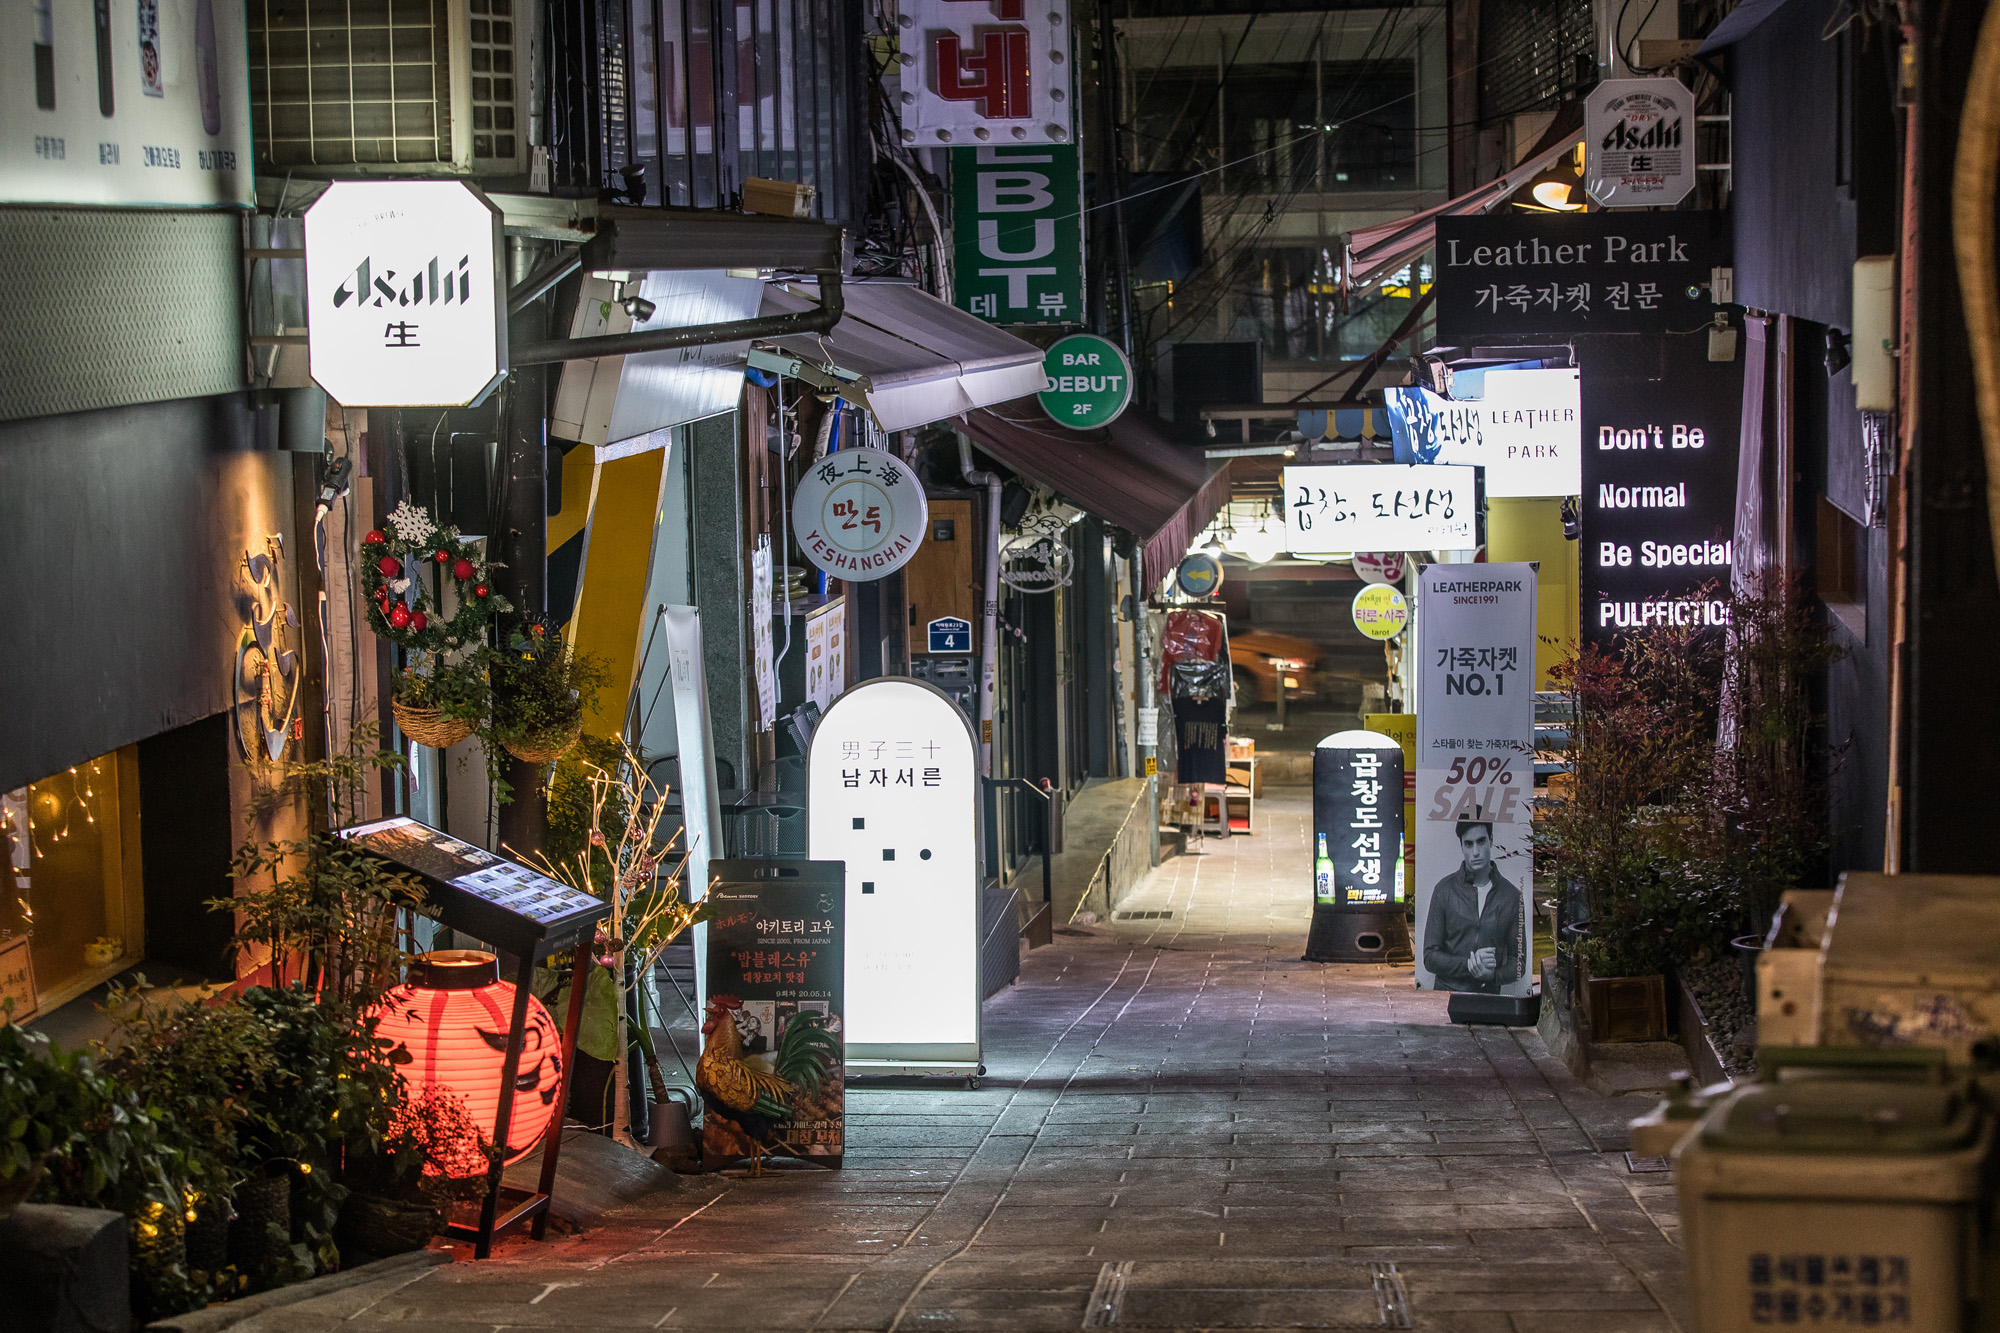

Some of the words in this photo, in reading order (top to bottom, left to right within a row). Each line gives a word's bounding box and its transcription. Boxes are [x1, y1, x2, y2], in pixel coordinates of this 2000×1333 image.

[1602, 115, 1682, 150] Asahi
[1631, 155, 1653, 171] 生
[1447, 237, 1592, 266] Leather
[1604, 235, 1690, 263] Park
[333, 254, 470, 308] Asahi
[1475, 283, 1591, 314] 가죽자켓
[1604, 282, 1663, 311] 전문
[384, 320, 421, 347] 生
[1062, 354, 1101, 366] BAR
[1047, 375, 1123, 393] DEBUT
[1072, 403, 1093, 415] 2F
[1492, 408, 1574, 429] LEATHER
[1599, 424, 1664, 450] Don't
[1672, 424, 1705, 449] Be
[1508, 445, 1559, 459] PARK
[817, 454, 903, 488] 夜上海
[1372, 488, 1455, 519] 도선생
[1599, 482, 1686, 508] Normal
[833, 499, 882, 534] 만두
[806, 530, 912, 571] YESHANGHAI
[1600, 542, 1632, 567] Be
[1641, 540, 1733, 568] Special
[1433, 580, 1522, 593] LEATHERPARK
[1600, 600, 1732, 627] PULPFICTIO
[945, 634, 955, 648] 4
[1437, 647, 1518, 671] 가죽자켓
[1446, 673, 1504, 696] NO.1
[842, 740, 942, 760] 男子三十
[1432, 739, 1465, 750] 스타들이
[1467, 739, 1484, 750] 찾는
[1446, 756, 1513, 785] 50%
[1428, 785, 1521, 822] SALE
[1349, 753, 1383, 885] 곱창도선생
[715, 911, 759, 930] ホルモン
[756, 919, 805, 935] 야키토리
[809, 919, 835, 935] 고우
[743, 971, 781, 984] 대창꼬치
[785, 971, 805, 984] 맛집
[798, 989, 832, 998] 20.05.14
